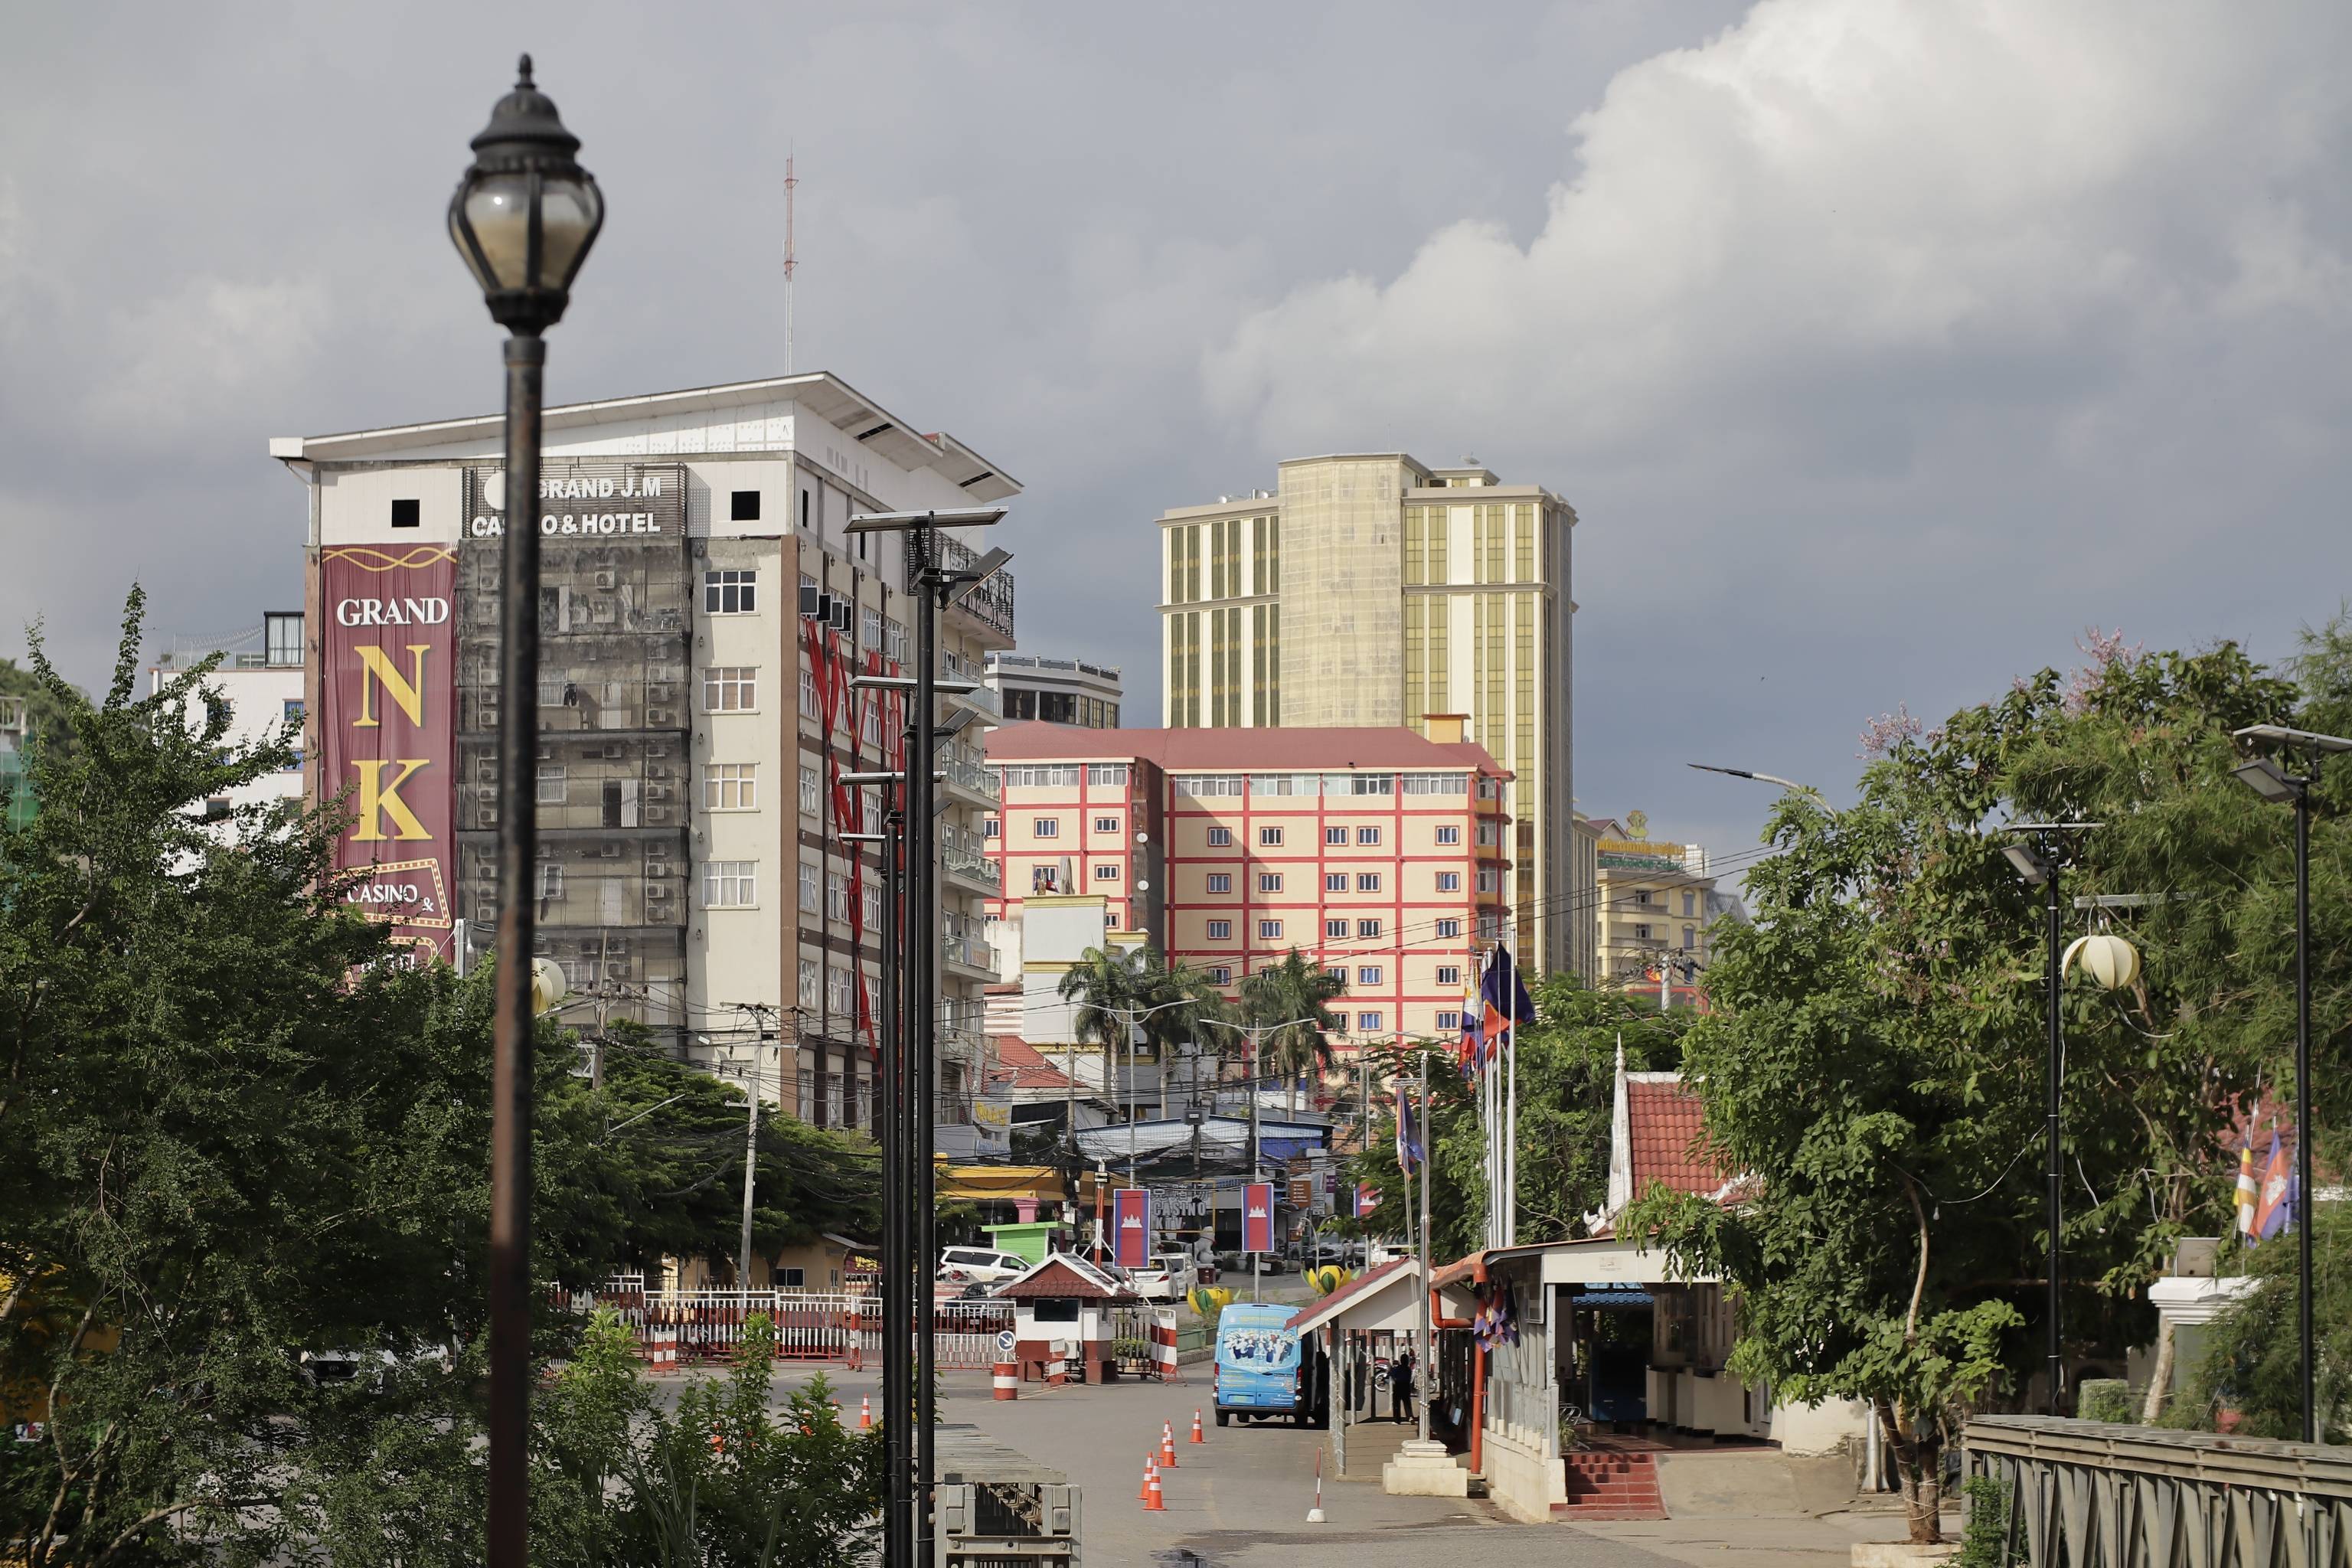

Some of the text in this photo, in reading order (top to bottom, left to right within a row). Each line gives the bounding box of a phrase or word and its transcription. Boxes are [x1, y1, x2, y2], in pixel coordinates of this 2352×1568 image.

[621, 477, 661, 497] J.M
[472, 514, 558, 536] CAO
[582, 512, 661, 534] HOTEL
[337, 597, 449, 626] GRAND
[353, 644, 430, 727] N
[350, 759, 433, 841] K
[347, 884, 418, 903] CASINO
[1153, 1201, 1207, 1217] CASINO
